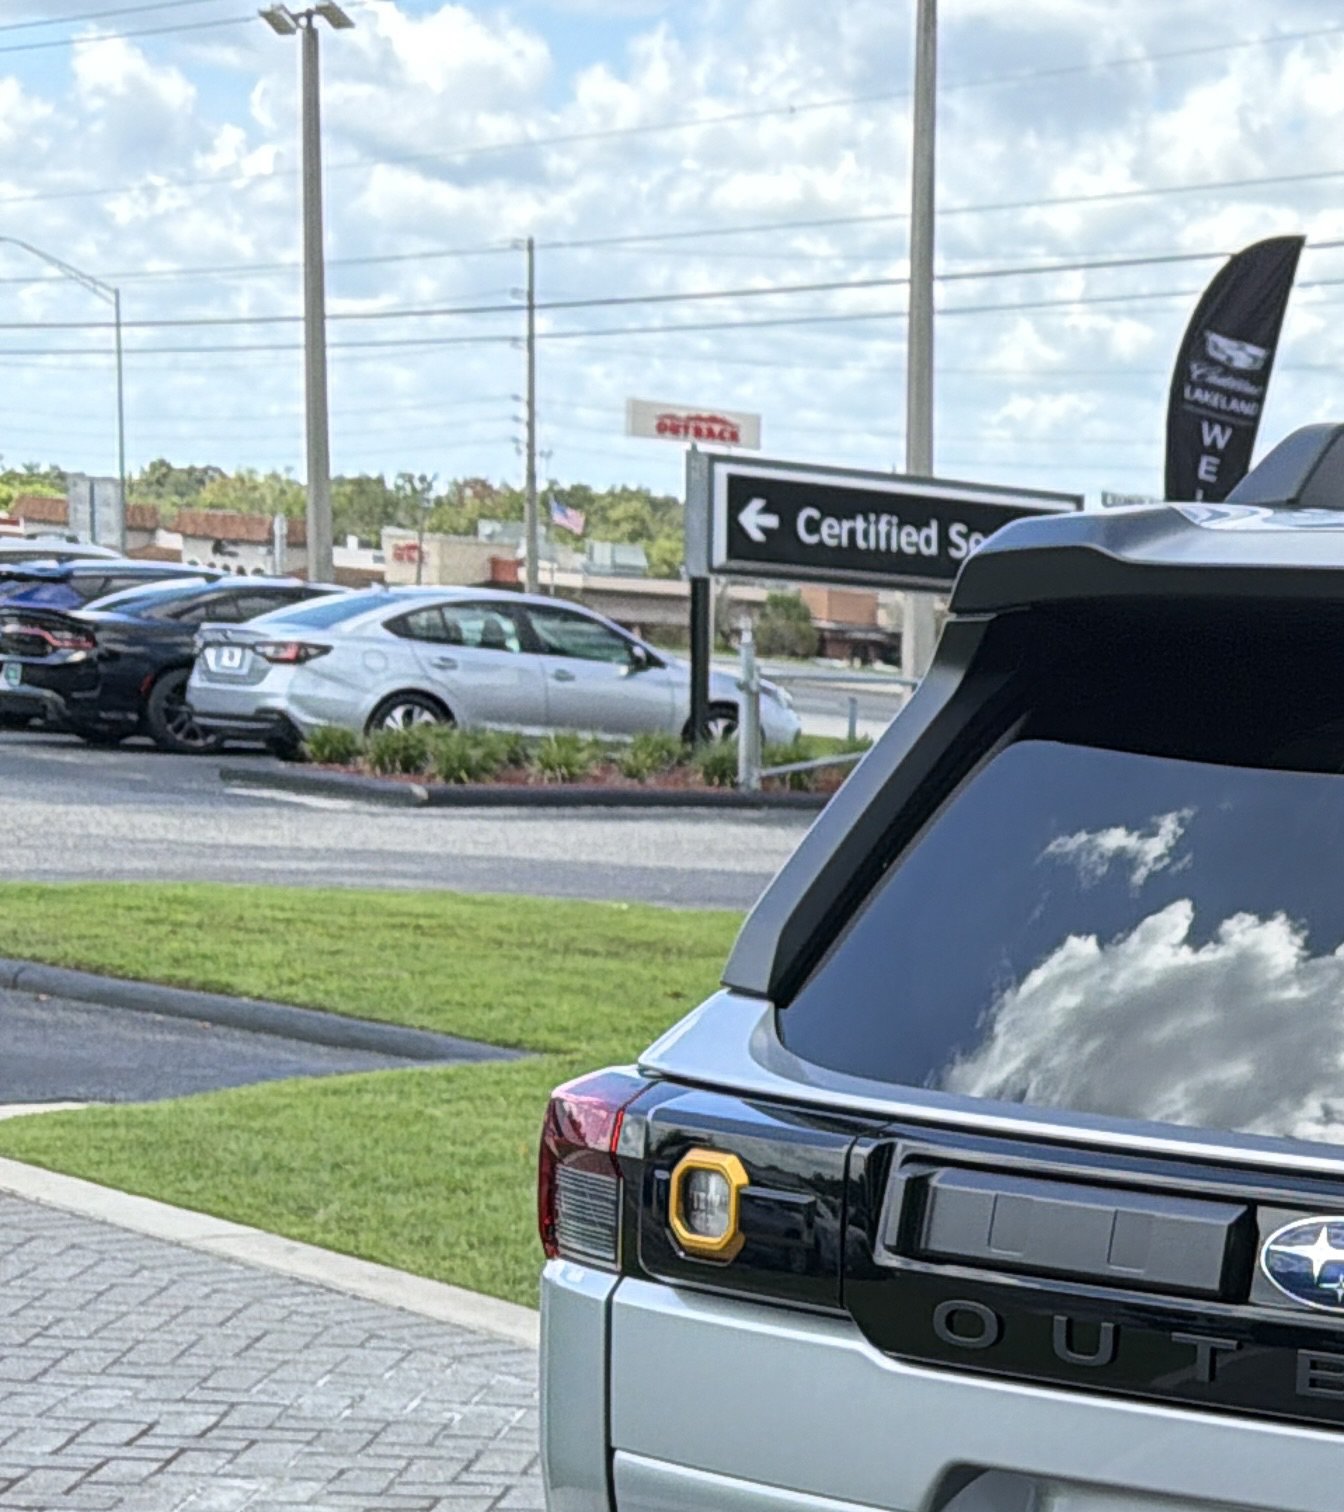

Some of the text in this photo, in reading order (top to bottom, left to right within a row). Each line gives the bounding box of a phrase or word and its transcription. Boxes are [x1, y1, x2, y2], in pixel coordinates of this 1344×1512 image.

[1185, 386, 1259, 415] LAKELAND
[655, 418, 740, 443] OUTBACK
[796, 506, 939, 557] Certified
